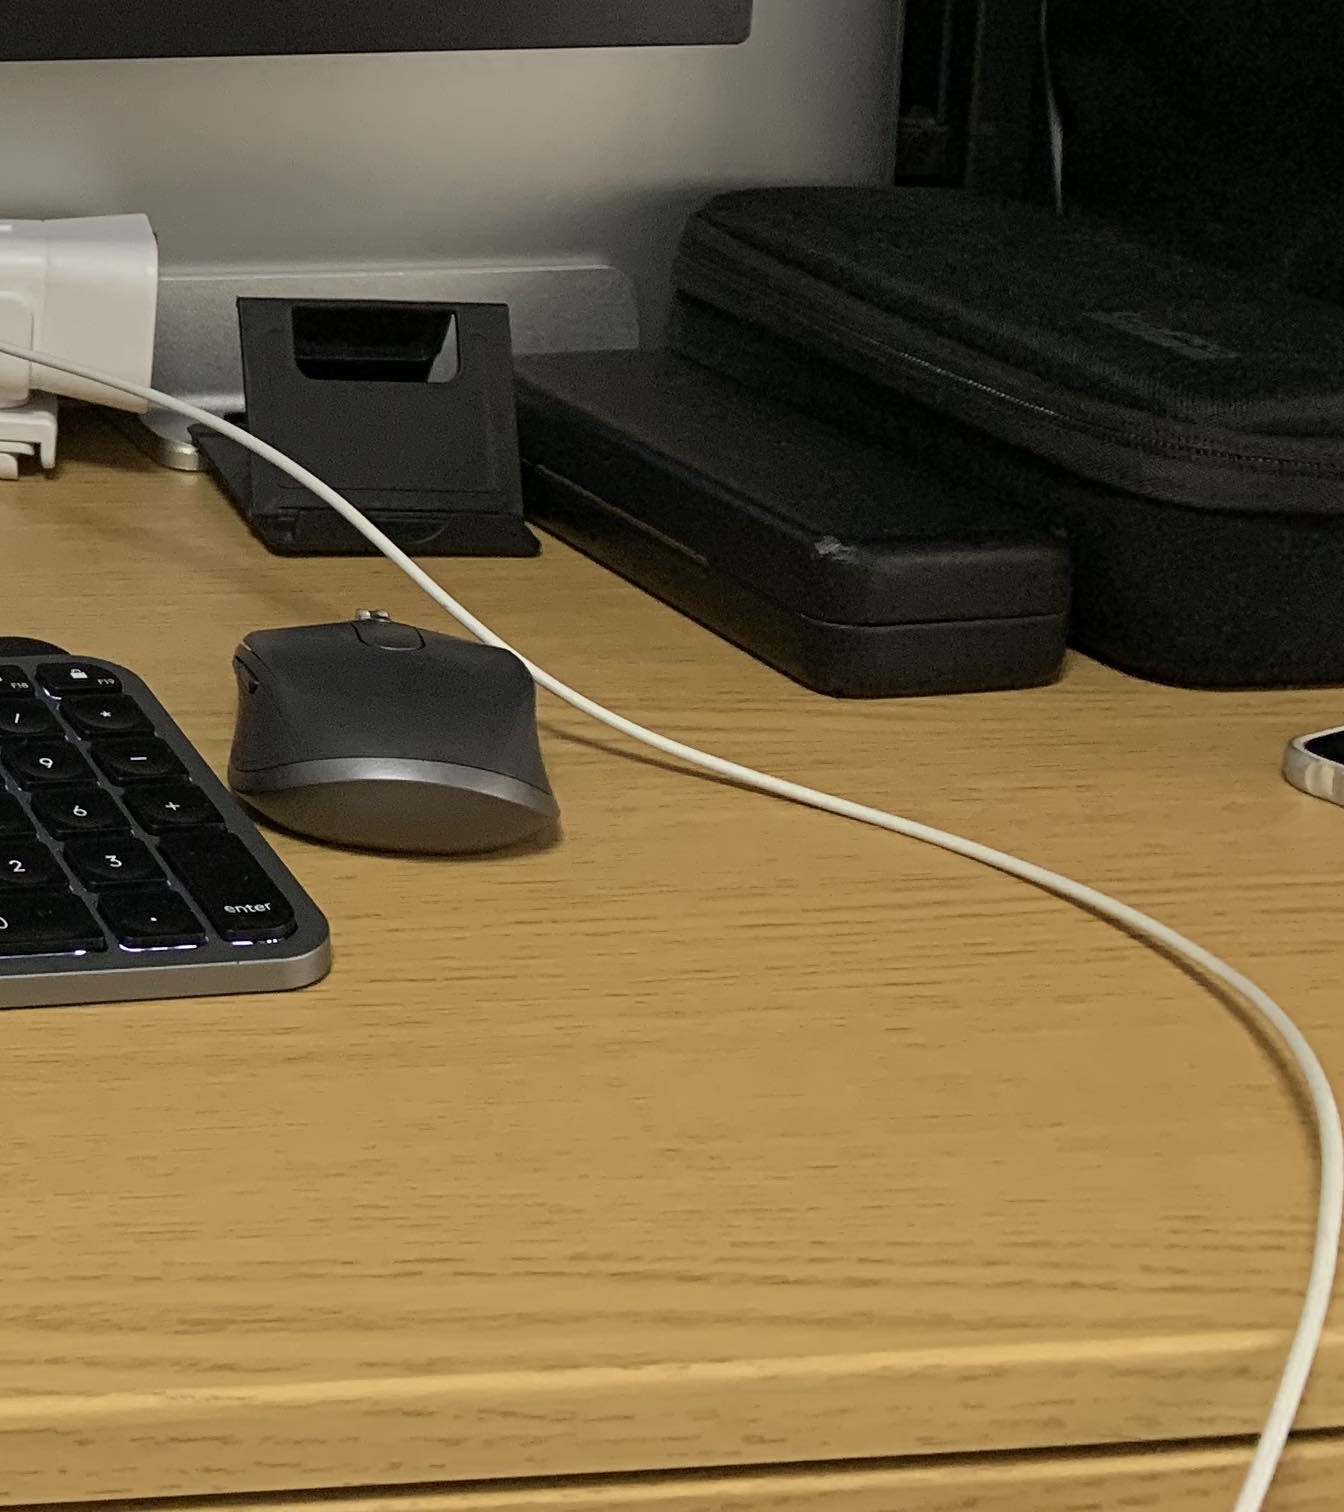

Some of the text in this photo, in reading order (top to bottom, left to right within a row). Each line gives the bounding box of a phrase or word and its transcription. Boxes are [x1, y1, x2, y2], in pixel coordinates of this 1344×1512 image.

[38, 757, 53, 768] 9
[72, 805, 88, 816] 6
[8, 860, 26, 872] 2
[104, 854, 123, 868] 3
[224, 902, 272, 914] enter
